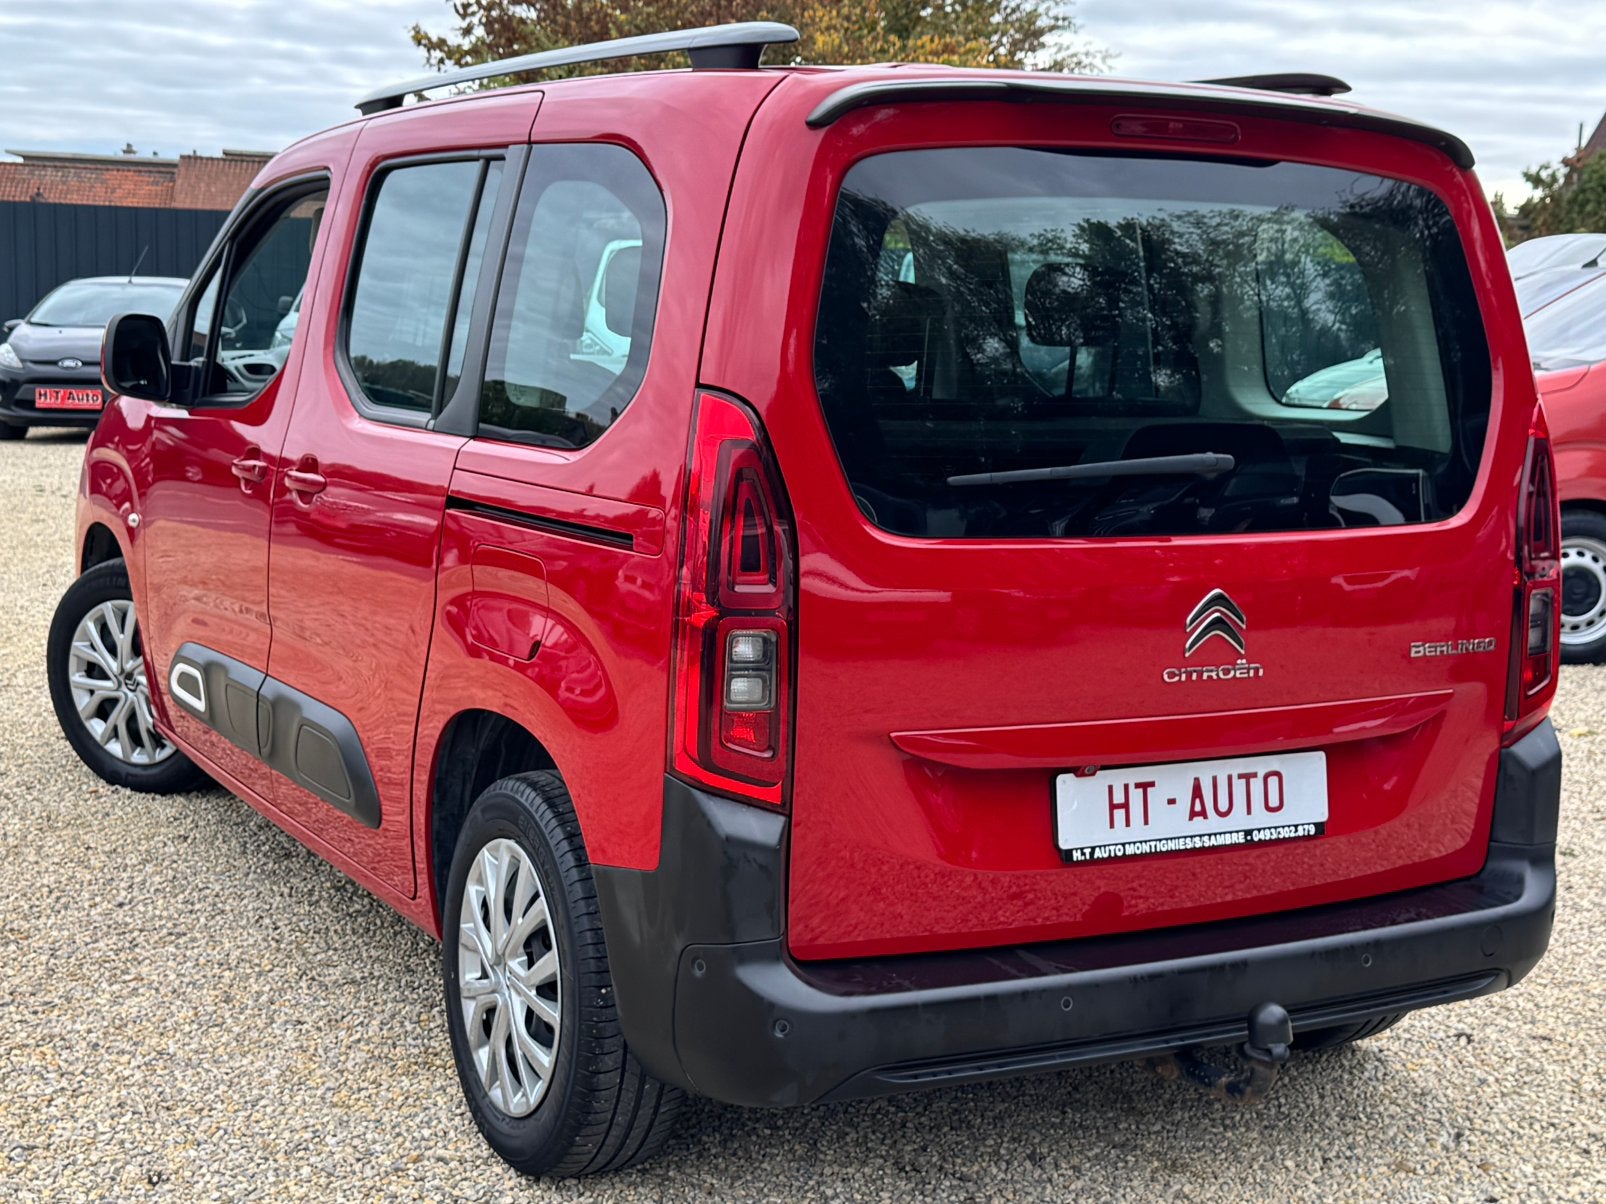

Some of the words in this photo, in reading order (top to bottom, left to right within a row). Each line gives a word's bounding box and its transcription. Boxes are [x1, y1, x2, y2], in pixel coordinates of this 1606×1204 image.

[38, 388, 63, 404] H.T
[67, 389, 100, 404] Auto
[1410, 637, 1496, 658] BERLINGO
[1107, 780, 1156, 829] HT
[1188, 770, 1285, 821] AUTO
[1072, 848, 1092, 861] H.T
[1094, 843, 1124, 859] AUTO
[1125, 831, 1246, 855] MONTIGNIES/S/SAMBRE
[1252, 823, 1316, 842] 0493/302.879
